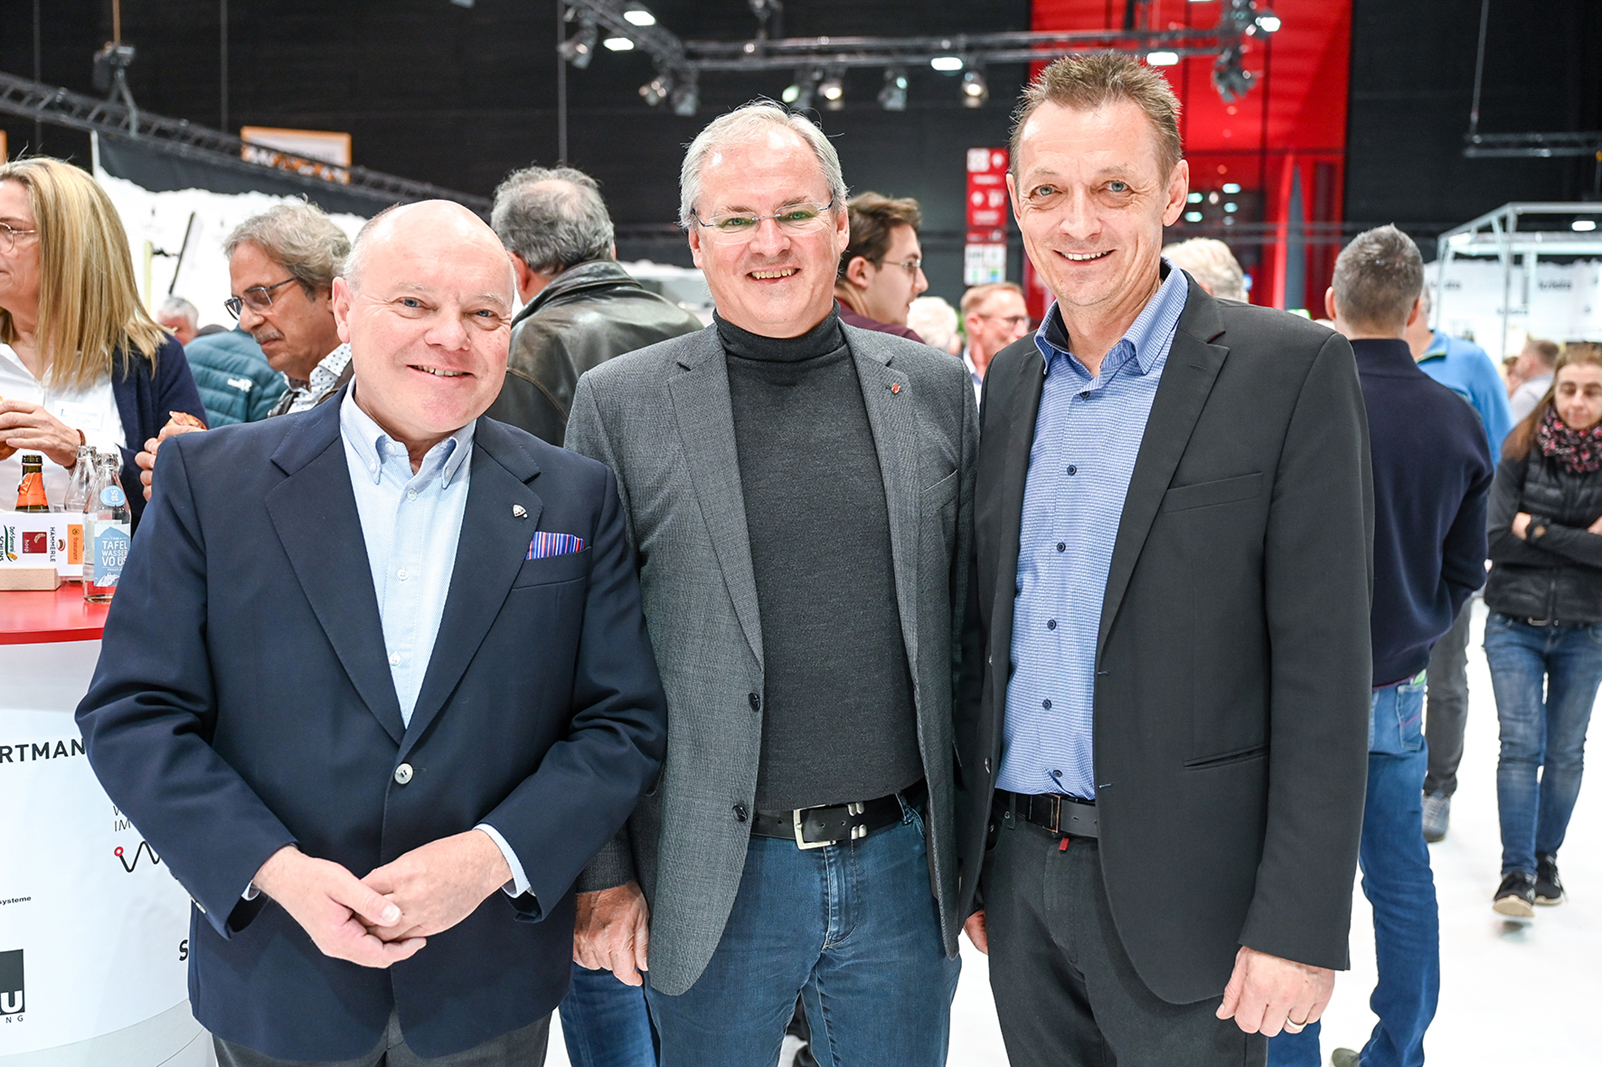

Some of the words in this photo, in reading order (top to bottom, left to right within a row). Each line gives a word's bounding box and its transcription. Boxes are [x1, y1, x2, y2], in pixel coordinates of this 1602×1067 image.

[102, 540, 128, 550] TAFEL
[101, 549, 128, 557] WASSER
[101, 556, 116, 567] VO
[0, 738, 86, 764] RTMAN
[0, 896, 32, 906] systeme
[0, 990, 23, 1014] U
